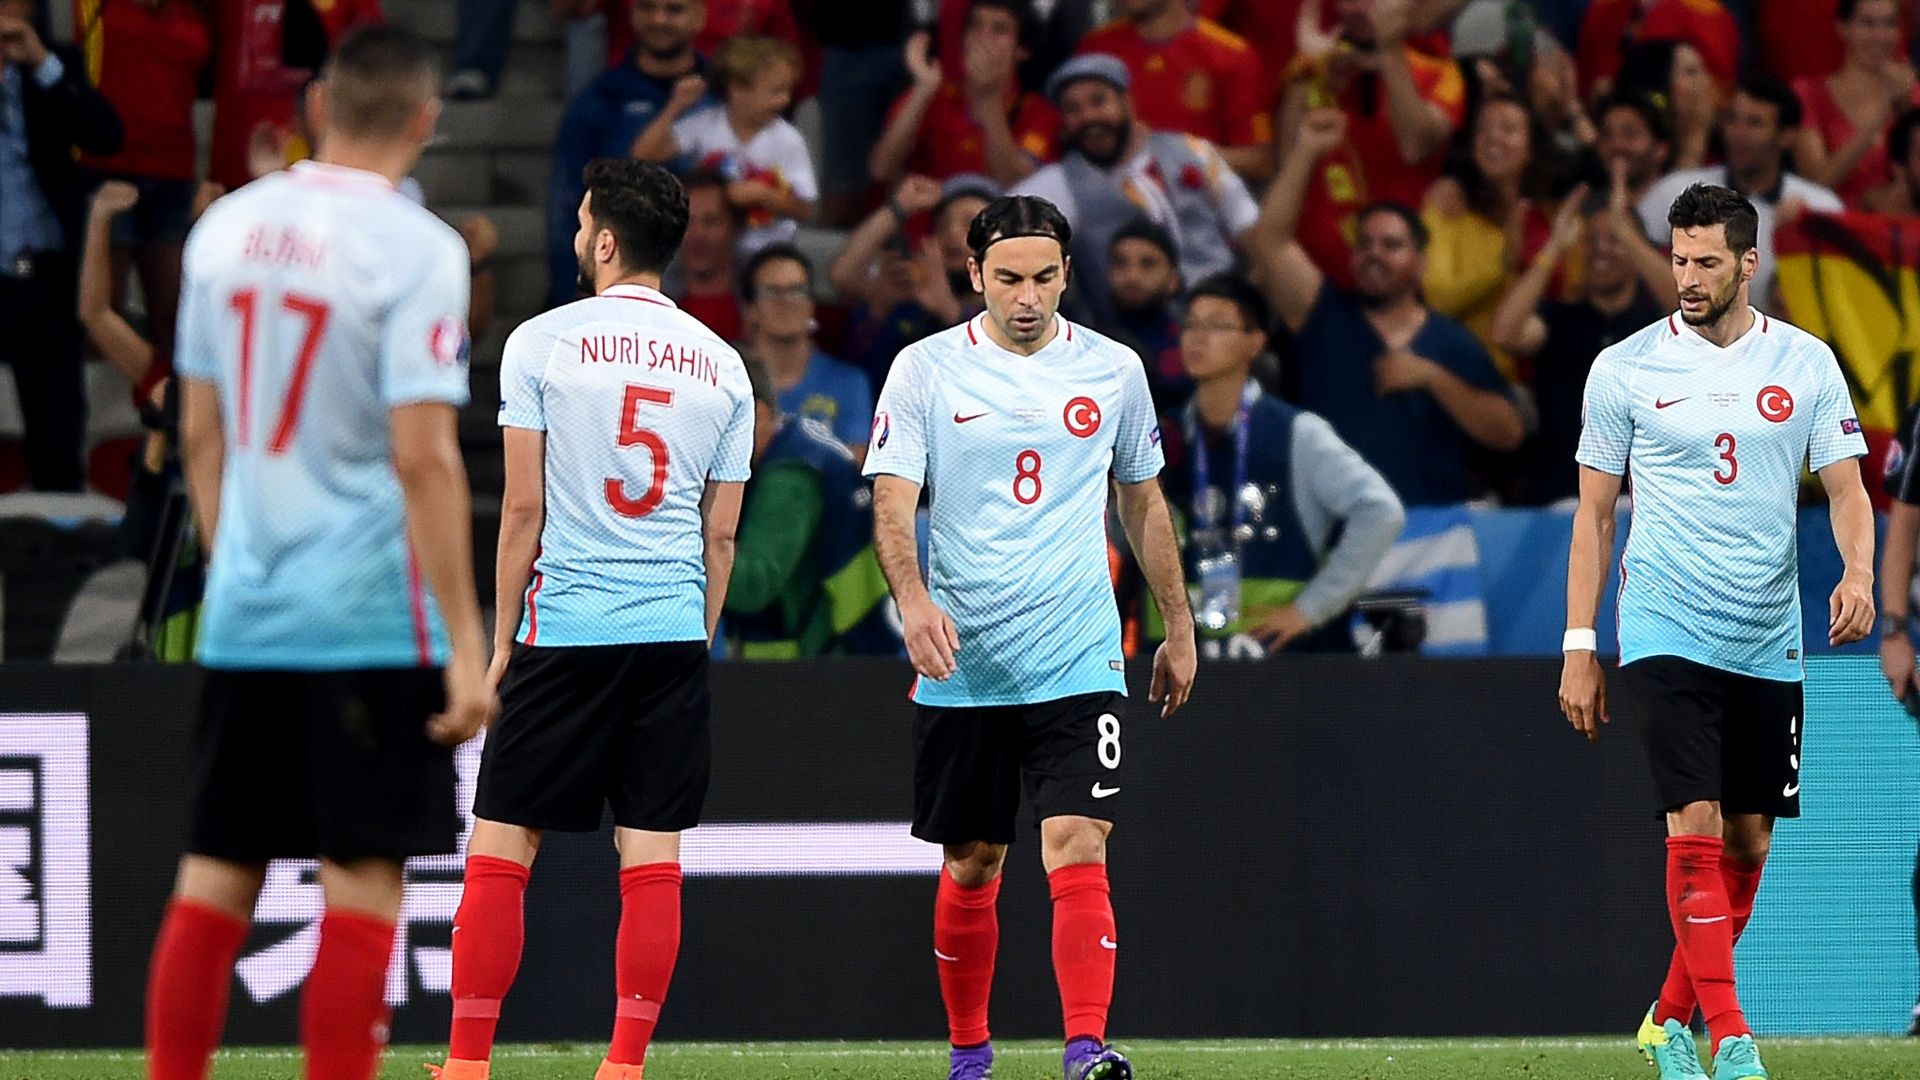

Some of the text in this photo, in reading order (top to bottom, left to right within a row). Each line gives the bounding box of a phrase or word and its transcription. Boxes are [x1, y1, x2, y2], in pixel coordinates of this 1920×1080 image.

[228, 287, 330, 457] 17
[580, 331, 718, 387] NURİ ŞAHİN
[604, 383, 673, 518] 5
[1012, 449, 1043, 505] 8
[1714, 432, 1739, 486] 3
[1097, 713, 1121, 770] 8
